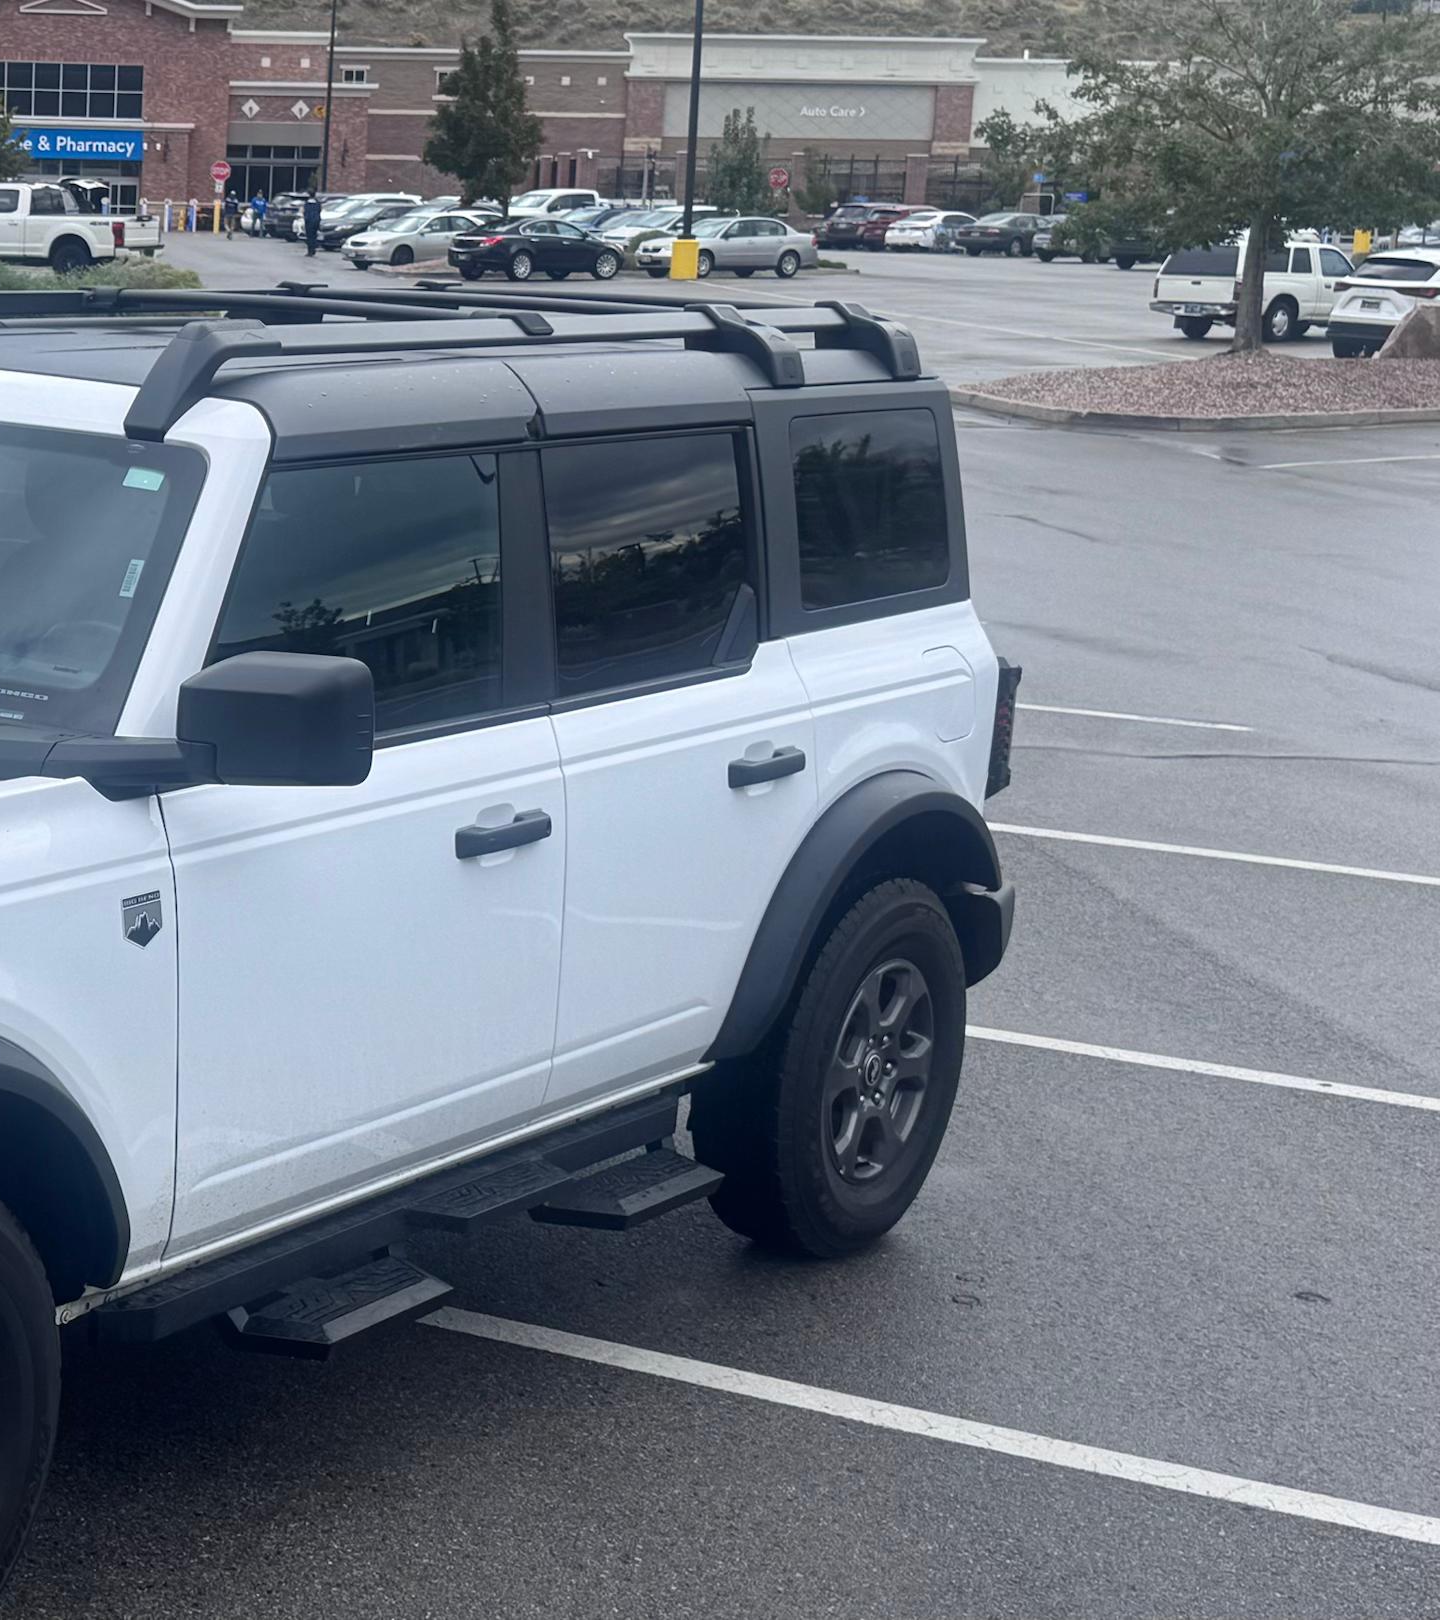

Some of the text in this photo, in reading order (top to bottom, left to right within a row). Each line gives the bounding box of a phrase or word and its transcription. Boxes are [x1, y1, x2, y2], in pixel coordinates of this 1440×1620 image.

[800, 105, 857, 117] Auto Care
[37, 135, 51, 151] &
[56, 135, 136, 158] Pharmacy
